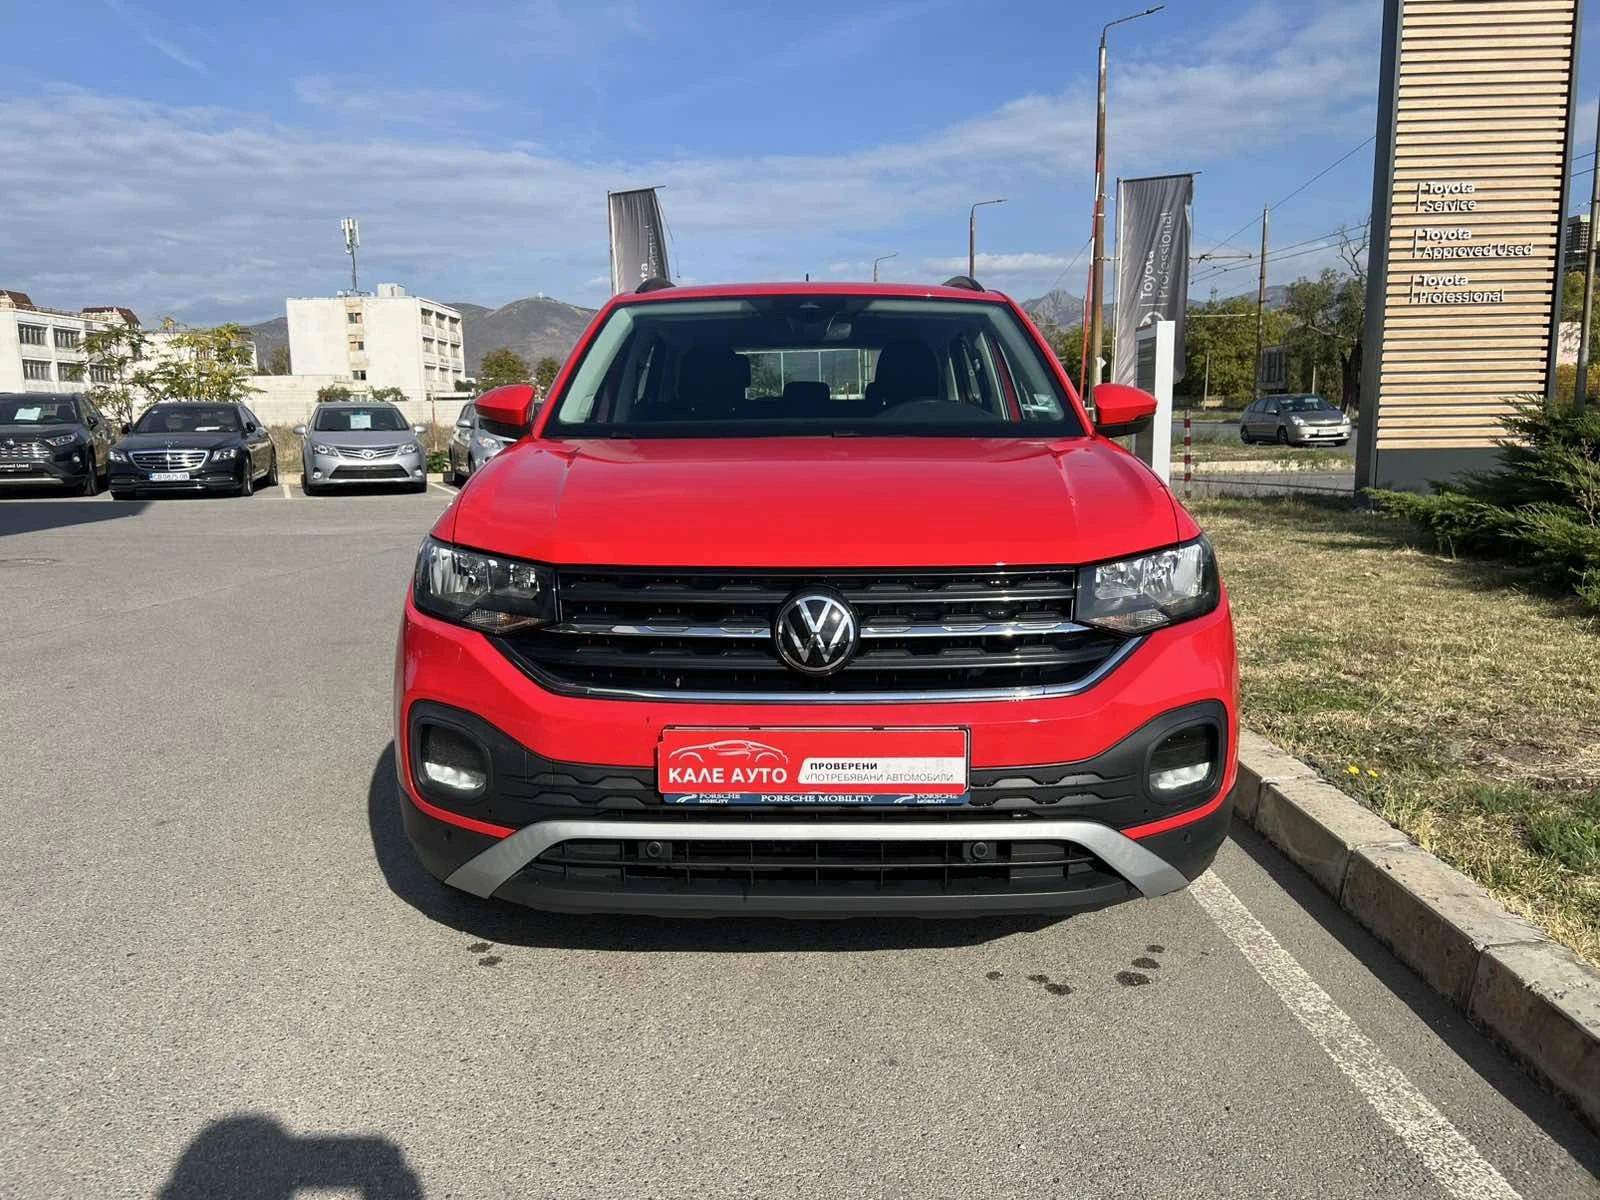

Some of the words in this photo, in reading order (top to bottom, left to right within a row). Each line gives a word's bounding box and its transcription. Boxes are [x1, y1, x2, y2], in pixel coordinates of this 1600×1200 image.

[1427, 181, 1476, 196] Toyota
[1425, 199, 1478, 211] Service
[1424, 228, 1472, 242] Toyota
[1422, 244, 1493, 259] Approved
[1496, 242, 1534, 256] Used
[1140, 250, 1157, 299] Toyota
[1421, 274, 1470, 288] Toyota
[1418, 289, 1505, 303] Professional
[809, 762, 878, 770] ПРОВЕРЕНИ
[668, 767, 725, 784] КАЛЕ
[730, 767, 788, 784] АУТО
[804, 773, 884, 782] УПОТРЕБЯВАНИ
[885, 773, 954, 782] АВТОМОБИЛИ
[760, 794, 816, 802] PORSCHE
[818, 794, 875, 802] MOBILITY
